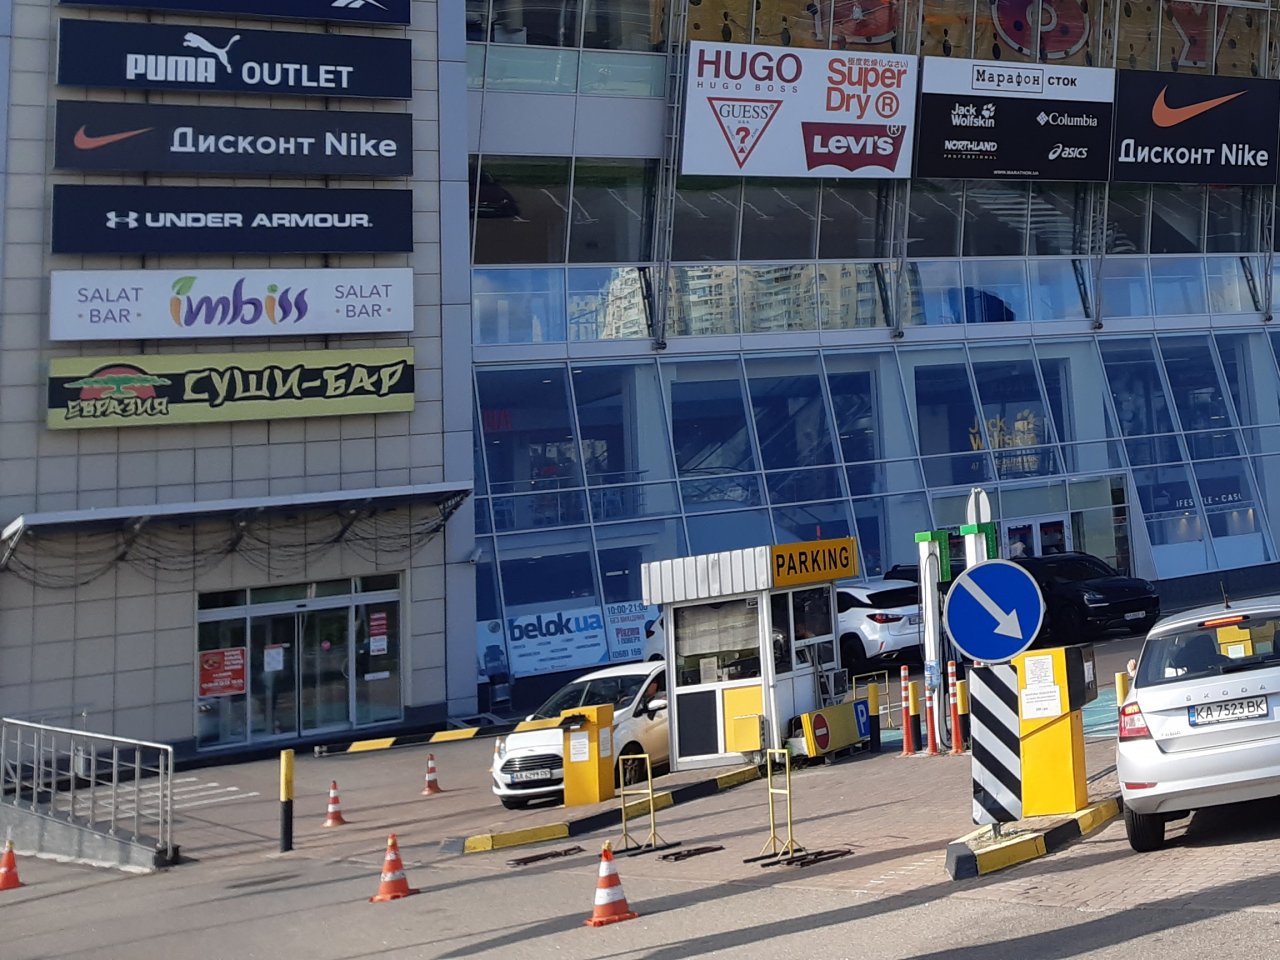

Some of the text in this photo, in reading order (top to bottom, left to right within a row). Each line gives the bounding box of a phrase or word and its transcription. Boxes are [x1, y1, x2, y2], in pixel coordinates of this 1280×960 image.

[126, 54, 354, 88] PUMA OUTLET
[697, 49, 802, 83] HUGO
[827, 58, 907, 94] Super
[697, 81, 798, 93] HUGO BOSS
[975, 69, 1041, 87] Марафон
[719, 103, 769, 119] GUESS
[826, 86, 871, 120] Dry
[951, 103, 977, 116] Jack
[951, 114, 995, 128] Wolfskin
[1049, 113, 1098, 127] Columbia
[170, 127, 397, 157] Дисконт Nike
[944, 140, 998, 151] NORTHLAND
[1118, 138, 1269, 166] Дисконт Nike
[146, 212, 370, 228] UNDER ARMOUR
[77, 287, 143, 303] SALAT
[170, 276, 308, 327] imbiss
[334, 285, 392, 299] SALAT
[89, 308, 131, 324] BAR
[345, 303, 381, 318] BAR
[183, 360, 407, 407] СУШИ-БАР
[65, 397, 169, 419] ЕВРАЗИЯ
[776, 546, 849, 576] PARKING
[508, 612, 603, 641] belok.ua
[857, 704, 867, 733] P
[1196, 706, 1213, 720] KA
[1216, 702, 1244, 717] 7523
[1247, 699, 1264, 713] BK
